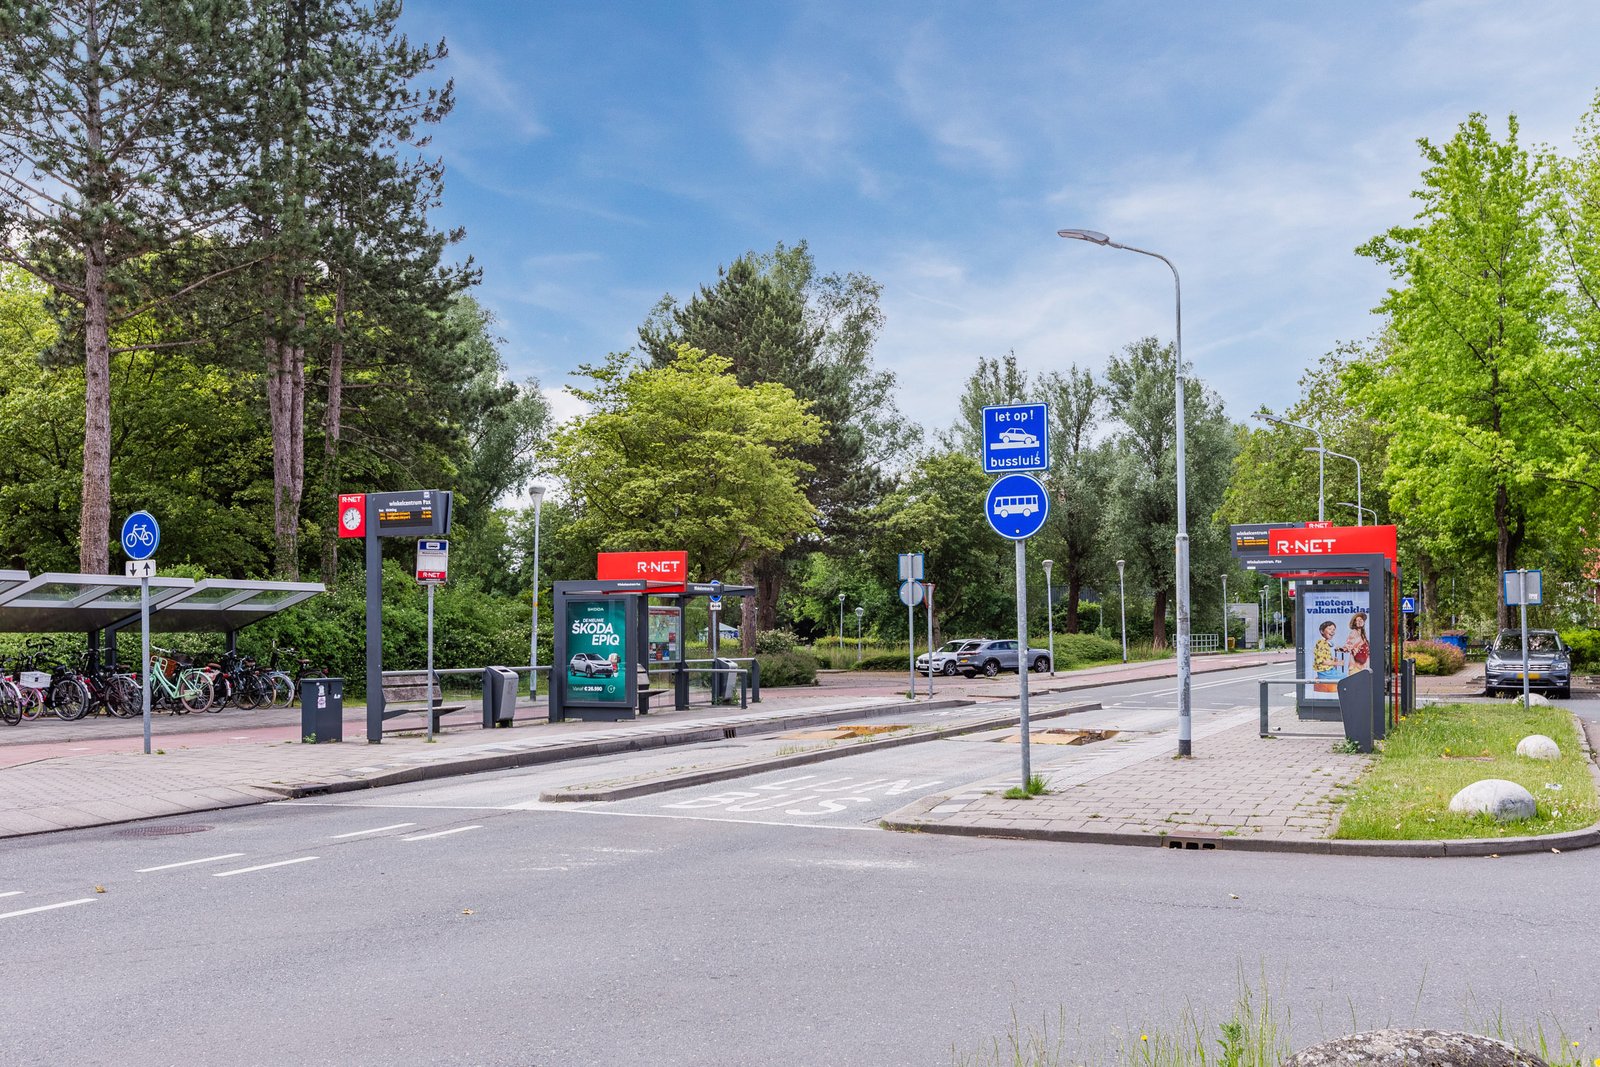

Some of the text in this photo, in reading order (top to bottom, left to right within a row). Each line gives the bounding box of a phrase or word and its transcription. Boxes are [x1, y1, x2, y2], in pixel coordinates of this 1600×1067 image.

[995, 411, 1010, 422] let
[990, 455, 1040, 467] bussluis
[572, 620, 614, 634] ŠKODA
[592, 634, 620, 645] EPIQ
[659, 791, 872, 816] BUS
